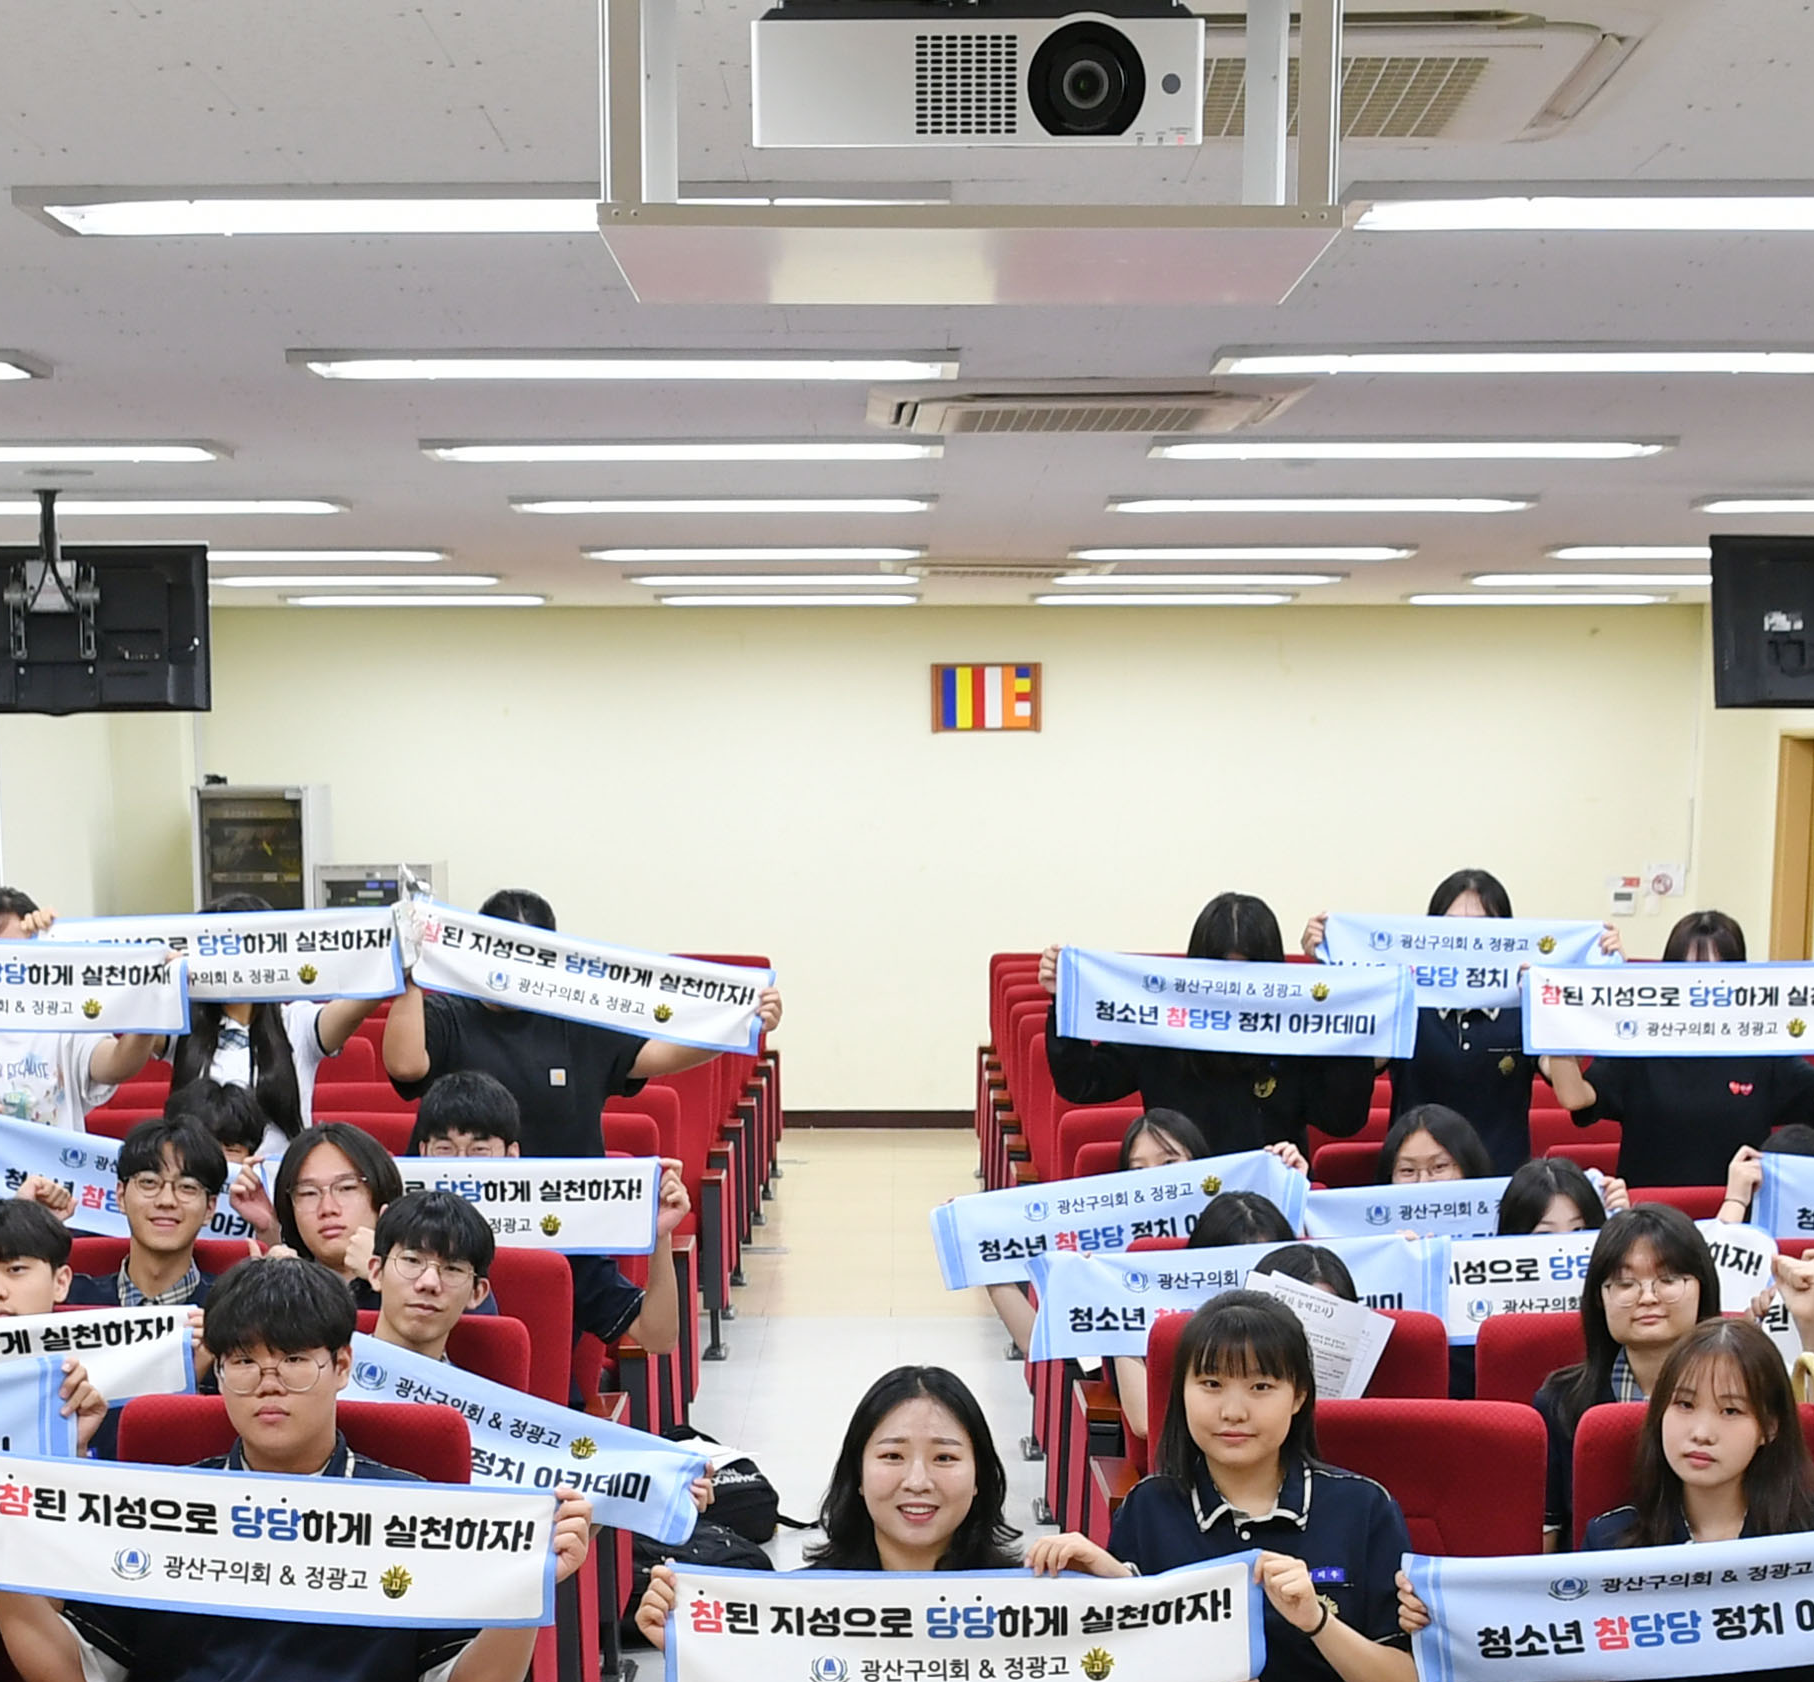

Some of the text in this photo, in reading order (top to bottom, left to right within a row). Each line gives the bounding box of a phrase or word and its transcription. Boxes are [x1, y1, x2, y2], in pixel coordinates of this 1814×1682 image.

[198, 933, 287, 955] 당당하게
[296, 928, 391, 951] 실천하자!
[1401, 935, 1528, 952] 광산구의회 정광고
[82, 960, 170, 985] 실천하자!
[250, 969, 290, 984] 정광고
[470, 933, 754, 1005] 지성으로 당당하게 실천하자!
[1467, 968, 1507, 988] 정치
[519, 979, 644, 1015] 광산구의회 정광고
[1173, 979, 1302, 998] 광산구의회 정광고
[1543, 985, 1583, 1006] 참된
[1592, 987, 1679, 1006] 지성으로
[1690, 987, 1778, 1006] 당당하게
[33, 1001, 72, 1015] 정광고
[1096, 1000, 1375, 1035] 청소년 참당당 정치 아카데미
[1648, 1022, 1777, 1036] 광산구의회 정광고
[540, 1179, 641, 1201] 실천하자!
[1058, 1183, 1194, 1214] 광산구의회 정광고
[1400, 1202, 1471, 1220] 광산구의회
[979, 1235, 1047, 1262] 청소년
[1055, 1225, 1124, 1251] 참당당
[1157, 1270, 1238, 1290] 광산구의회
[1498, 1293, 1584, 1319] 광산구의회
[1070, 1307, 1145, 1332] 청소년
[40, 1316, 173, 1351] 실천하자!
[389, 1377, 561, 1448] 광산구의회 & 정광고
[467, 1443, 524, 1485] 정치
[79, 1493, 218, 1534] 지성으로
[232, 1506, 371, 1545] 당당하게
[384, 1515, 534, 1552] 실천하자!
[164, 1556, 367, 1590] 광산구의회 & 정광고
[1601, 1562, 1813, 1593] 광산구의회 정광고
[691, 1588, 1231, 1638] 참된 지성으로 당당하게 실천하자!
[1478, 1620, 1584, 1658] 청소년
[1594, 1610, 1701, 1650] 참당당
[1712, 1602, 1783, 1640] 정치
[861, 1656, 1069, 1682] 광산구의회 & 정광고
